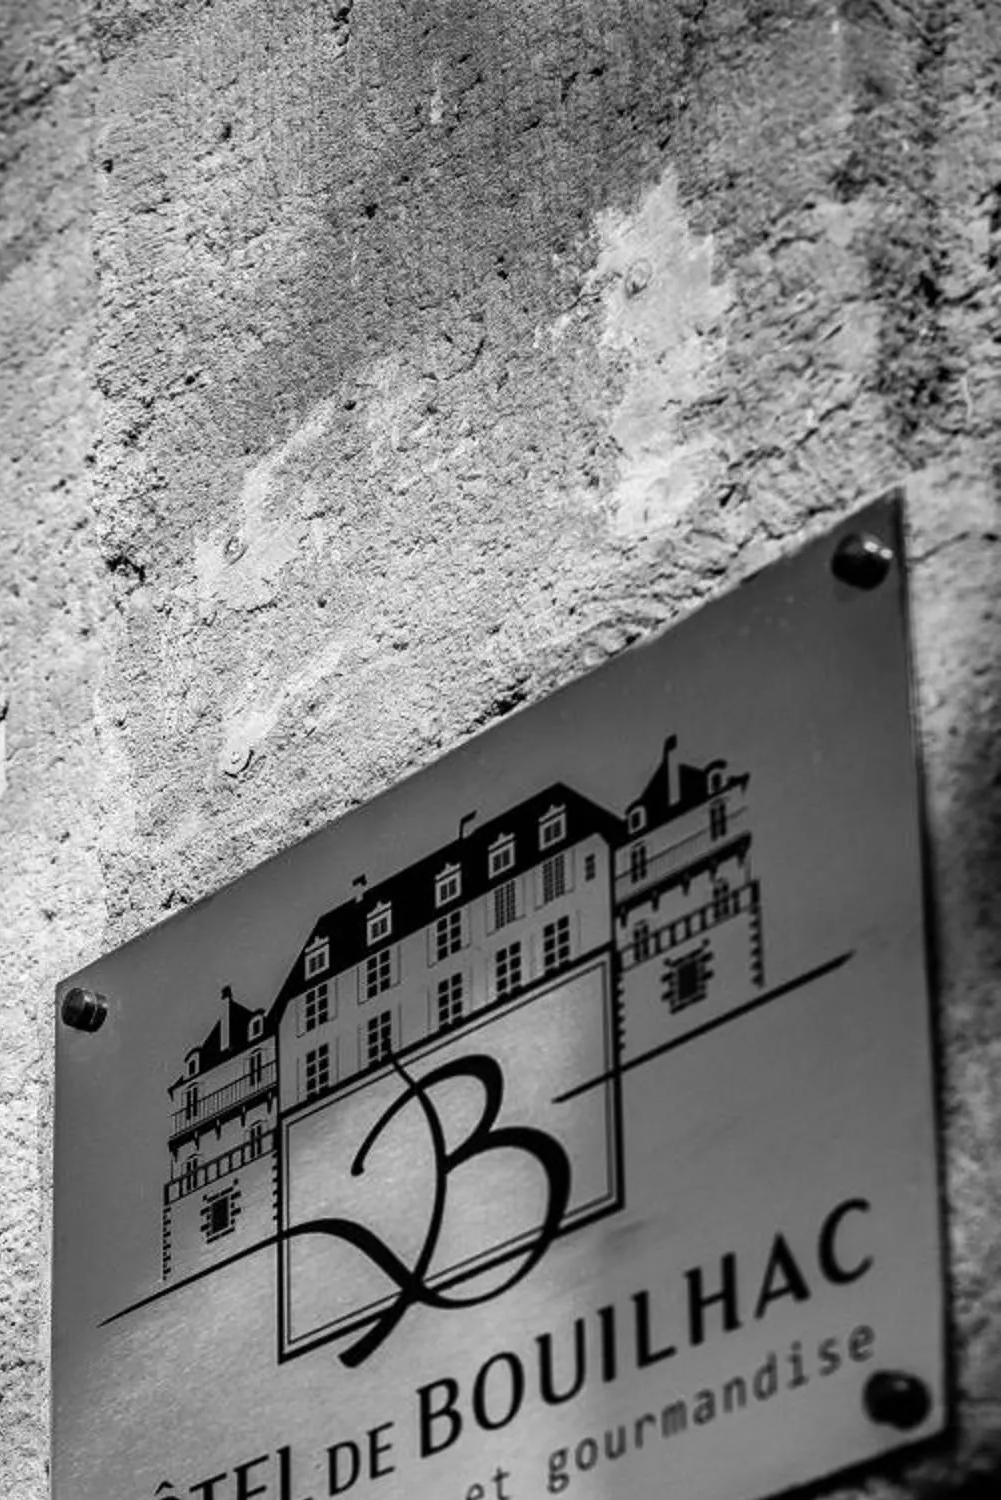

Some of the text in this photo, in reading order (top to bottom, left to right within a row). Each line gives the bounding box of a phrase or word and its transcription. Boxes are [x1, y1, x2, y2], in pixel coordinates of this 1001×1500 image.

[326, 1421, 396, 1497] DE
[415, 1197, 875, 1459] BOUILHAC
[545, 1319, 876, 1494] gourmandise
